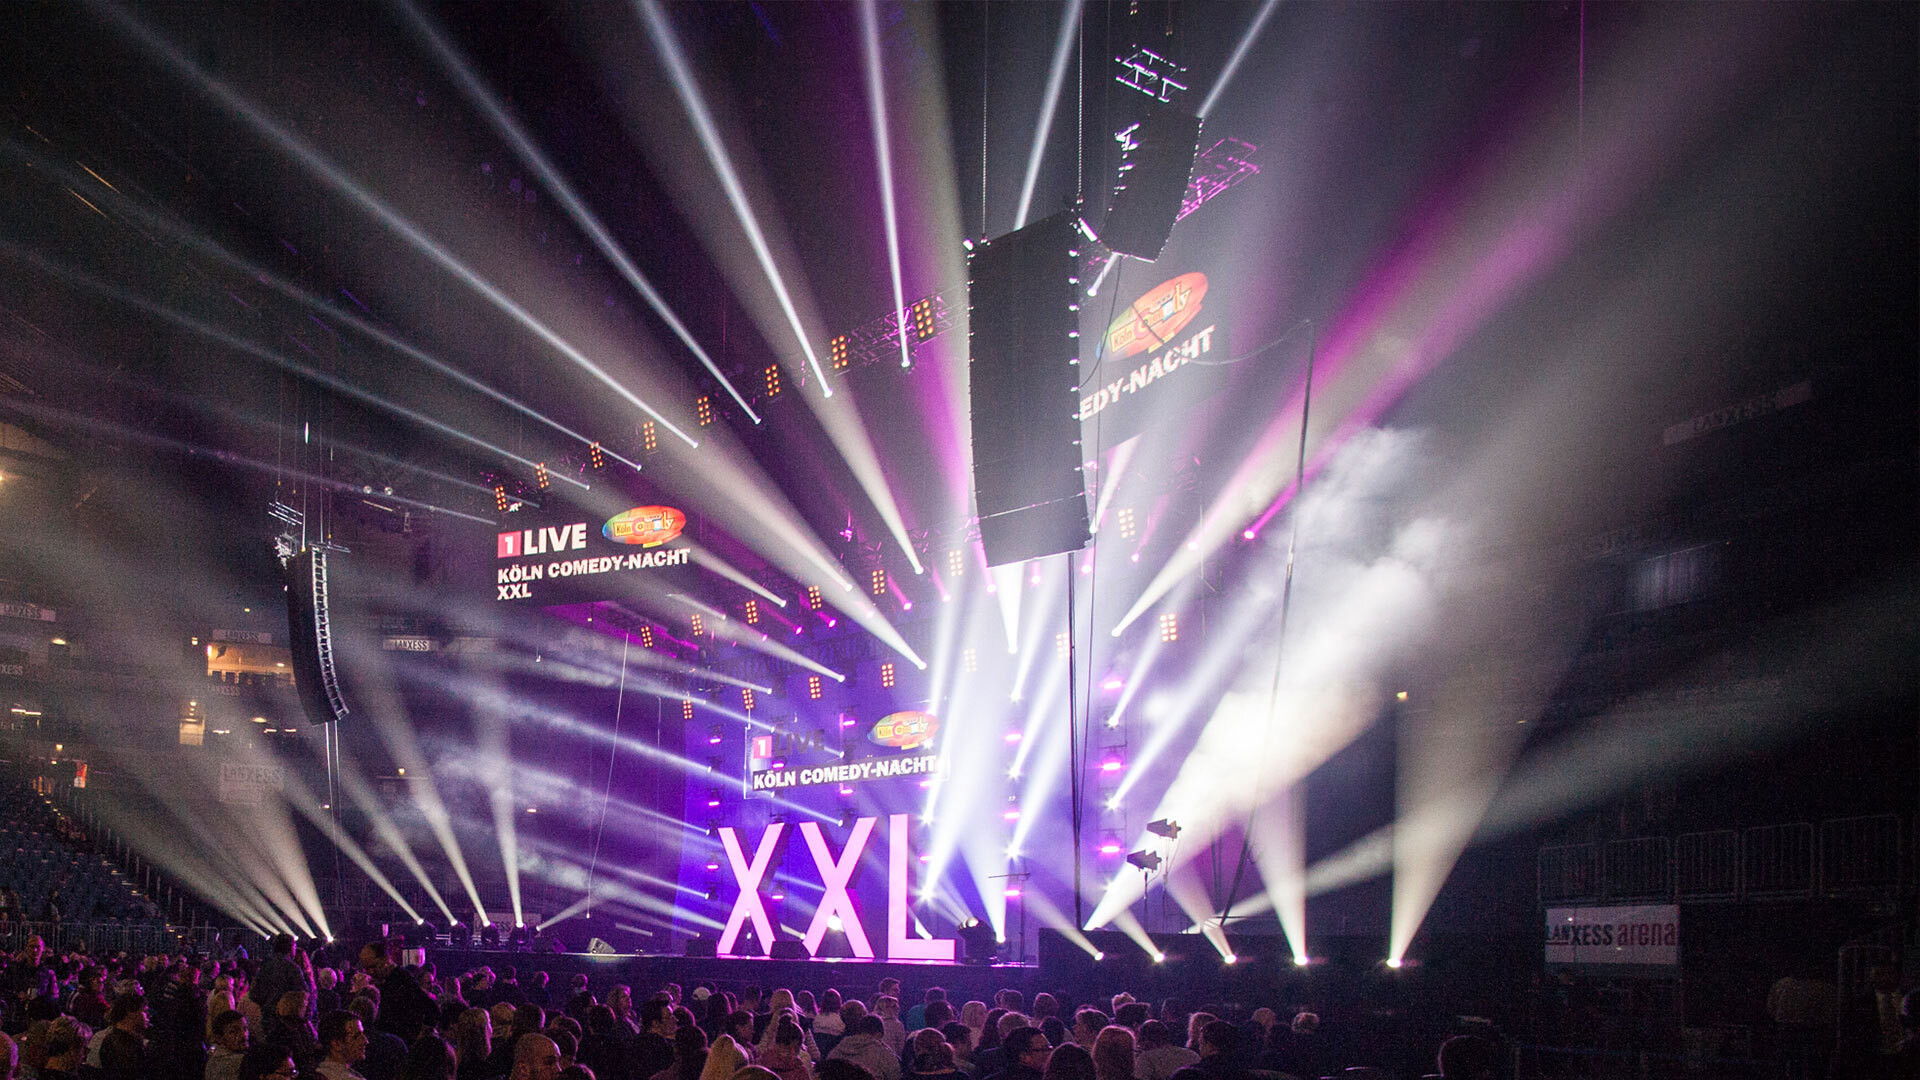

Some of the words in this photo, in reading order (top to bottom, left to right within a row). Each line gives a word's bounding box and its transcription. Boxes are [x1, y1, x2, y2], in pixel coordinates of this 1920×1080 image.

[1080, 325, 1215, 421] EDY-NACHT
[498, 564, 543, 583] KÖLN
[548, 548, 690, 578] COMEDY-NACHT
[497, 583, 532, 600] XXL
[753, 770, 796, 790] KÖLN
[800, 755, 938, 784] COMEDY-NACHT
[716, 814, 956, 960] XXL
[1617, 923, 1676, 946] arena
